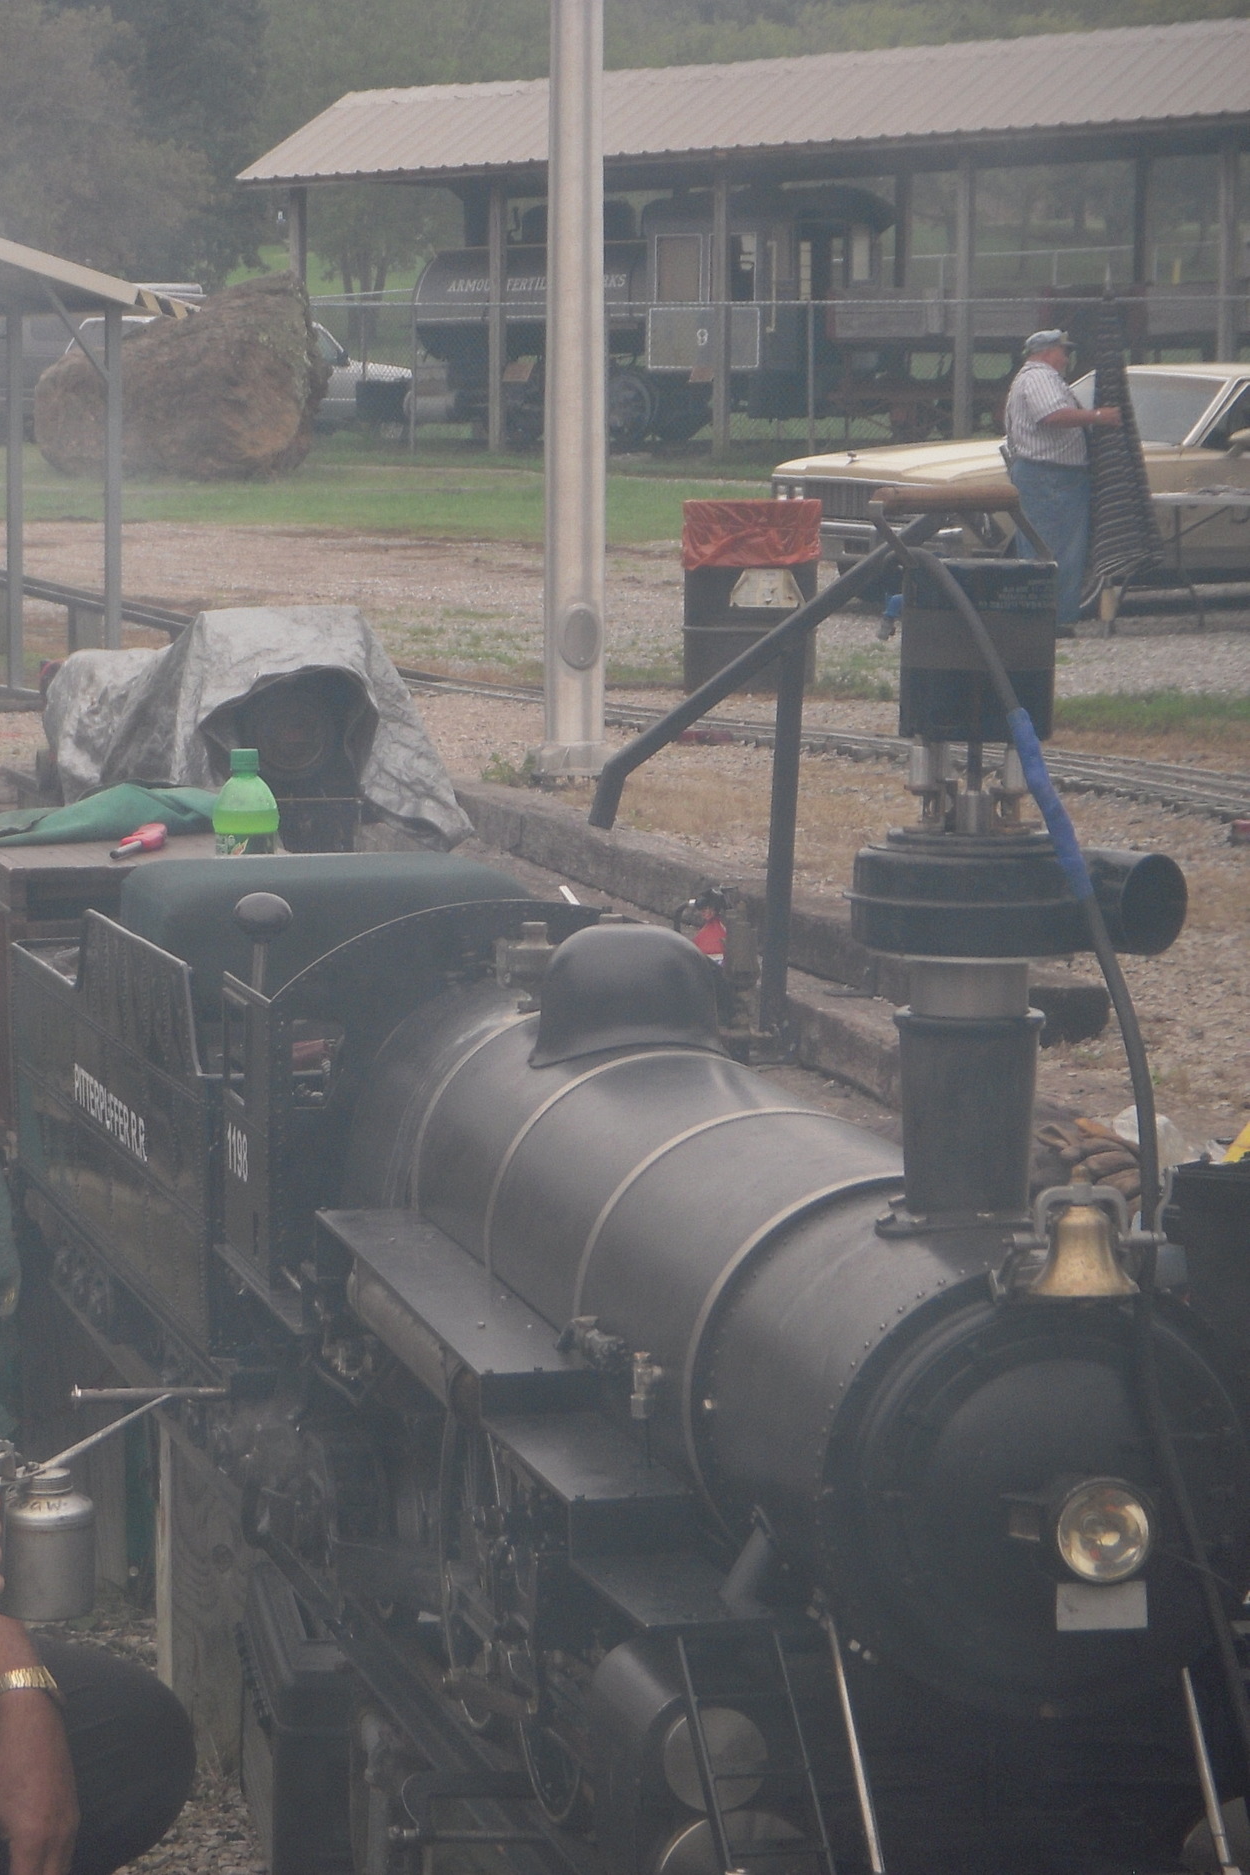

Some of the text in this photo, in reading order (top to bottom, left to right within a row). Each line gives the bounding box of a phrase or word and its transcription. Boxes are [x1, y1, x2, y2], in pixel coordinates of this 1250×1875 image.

[447, 273, 627, 293] ARMOU FERTIL RKS
[696, 328, 709, 346] 9
[74, 1062, 130, 1149] PITTERPUFFER
[227, 1122, 248, 1182] 1198
